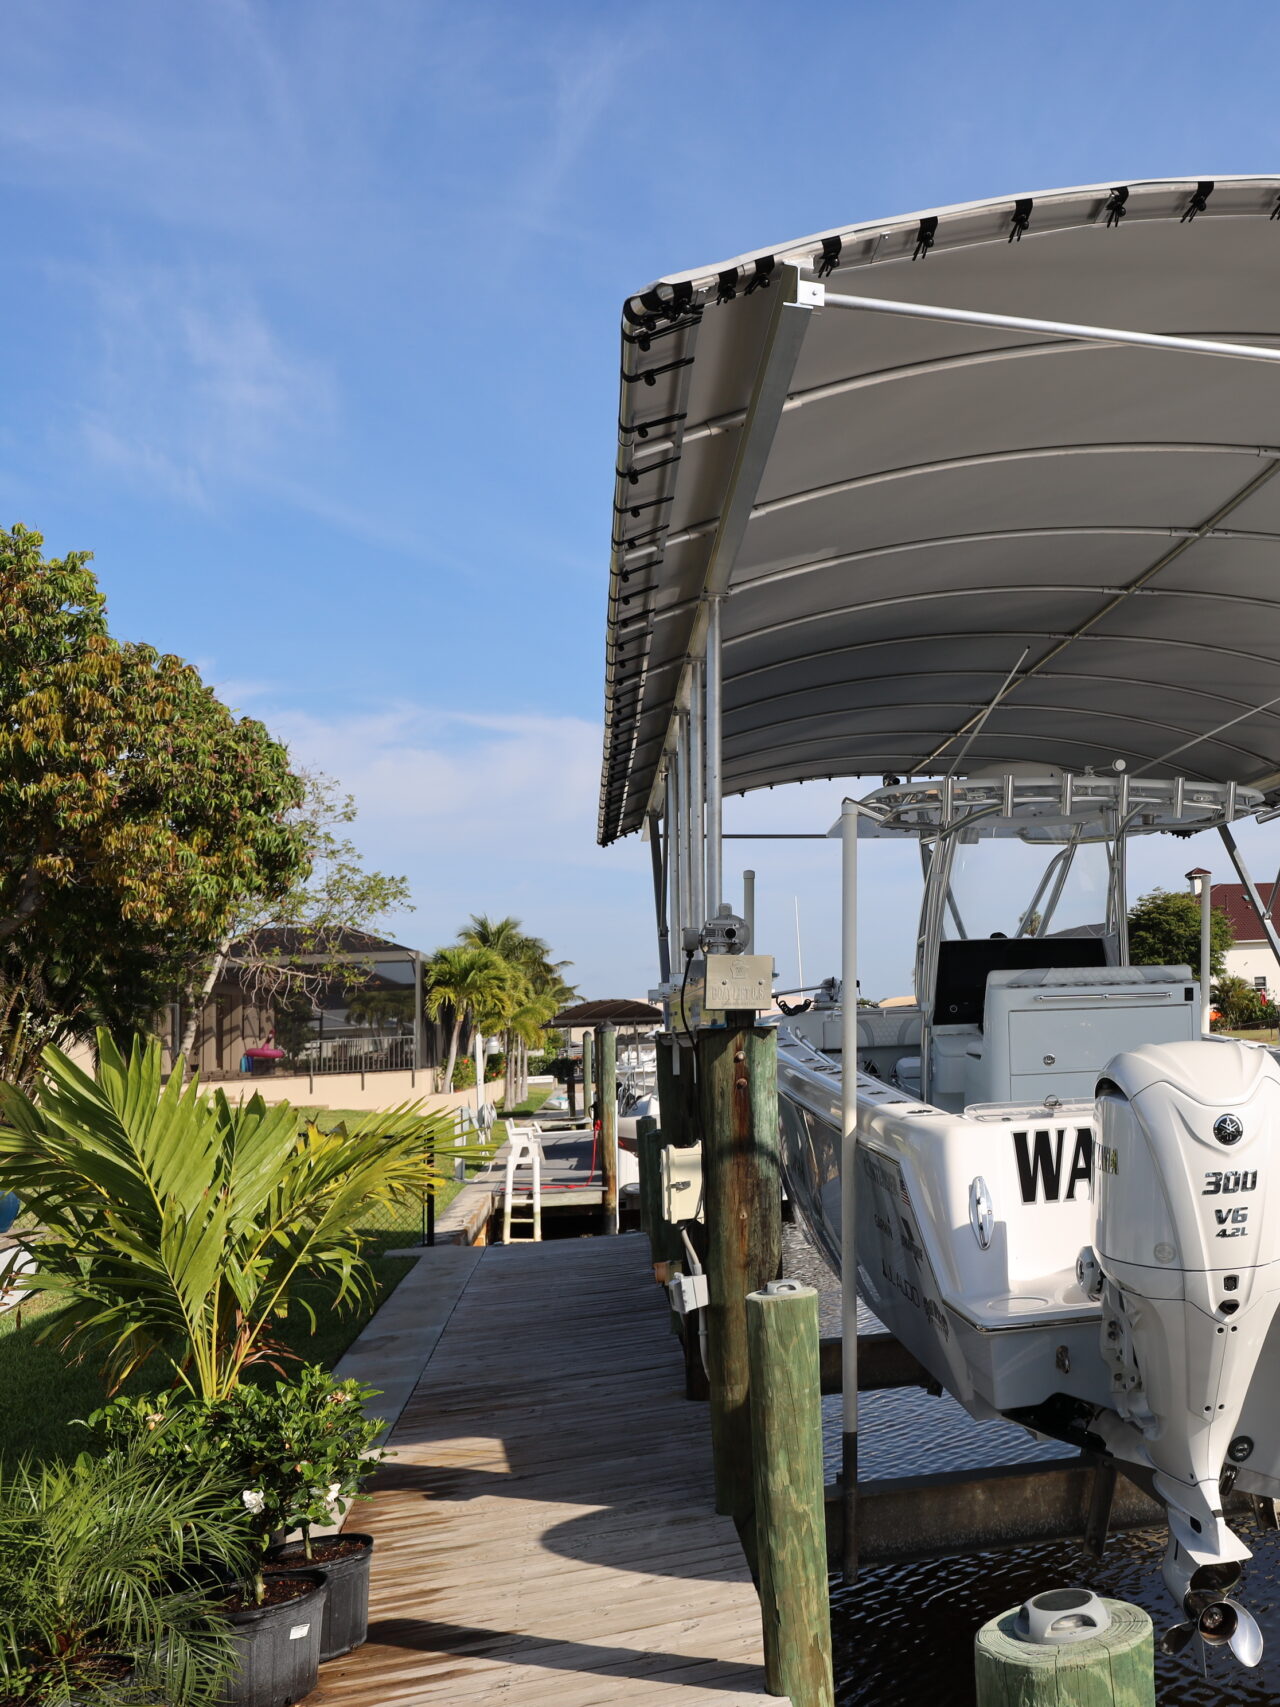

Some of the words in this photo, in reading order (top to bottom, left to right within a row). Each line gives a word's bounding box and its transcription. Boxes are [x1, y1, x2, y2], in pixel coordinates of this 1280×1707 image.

[1201, 1169, 1258, 1195] 300
[1214, 1206, 1249, 1225] V6
[1215, 1227, 1249, 1238] 4.2L
